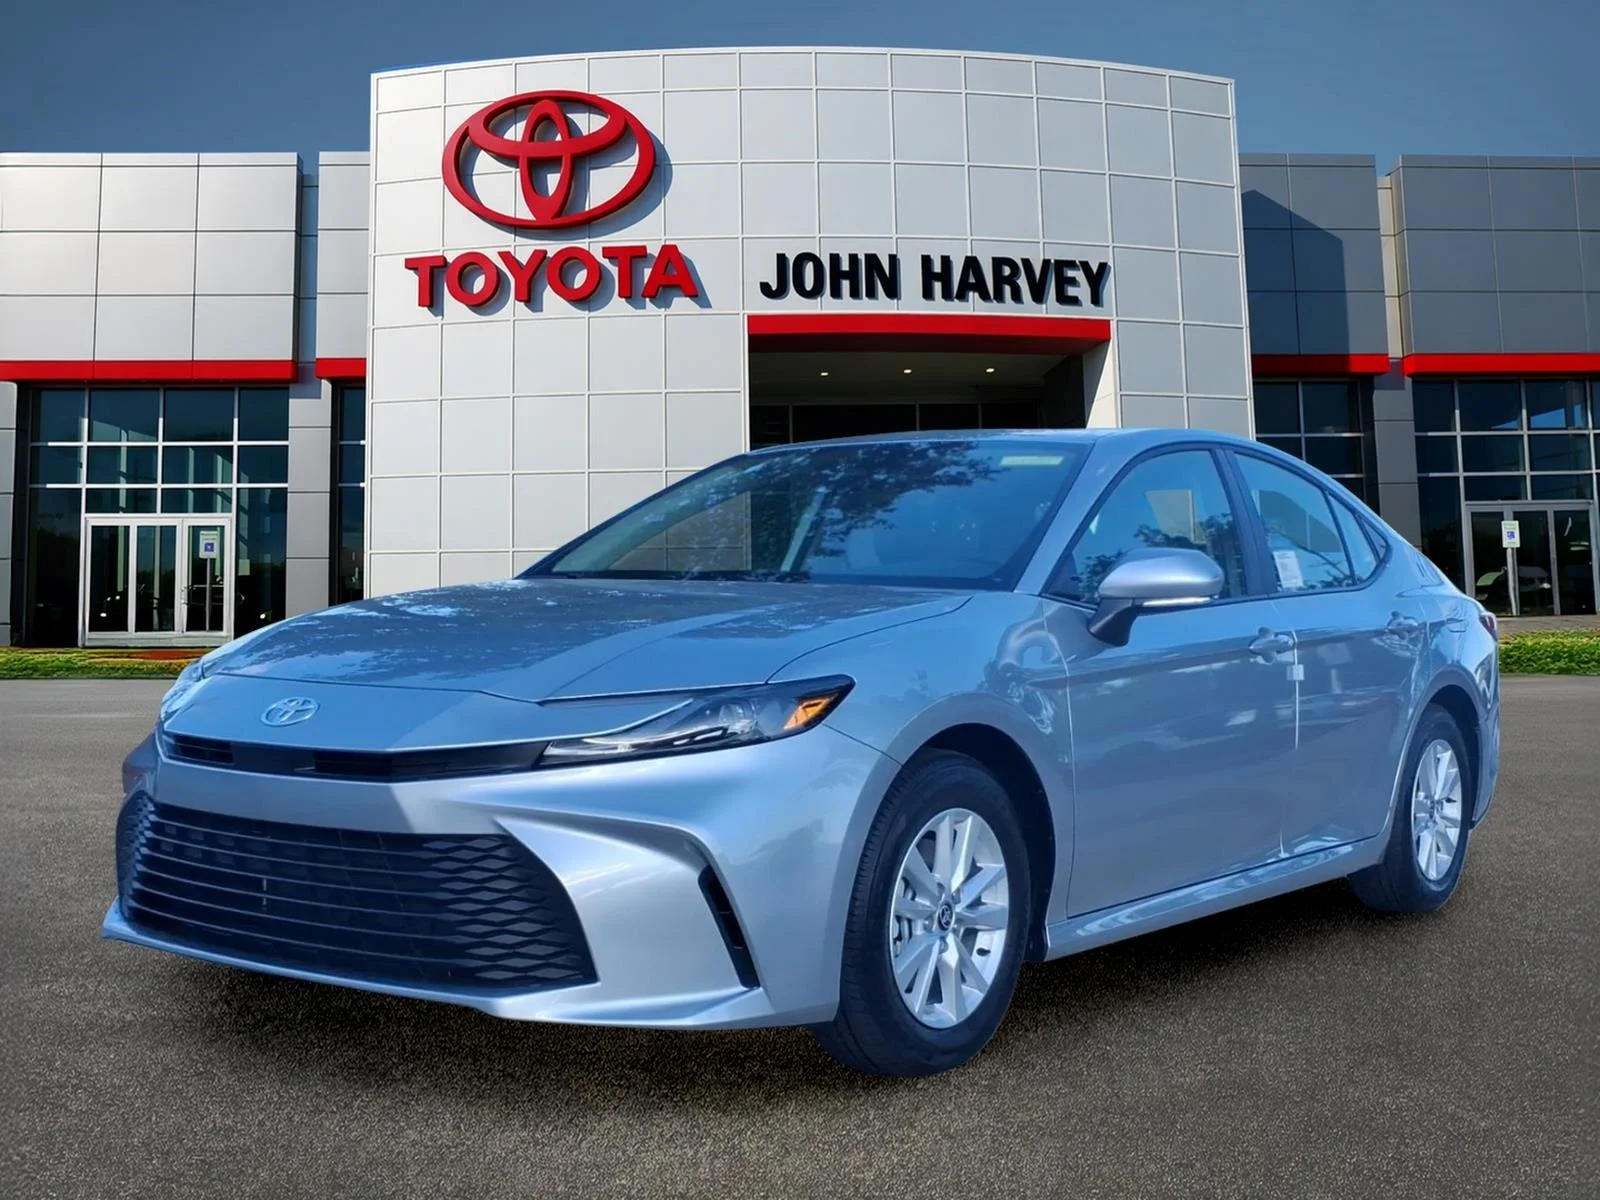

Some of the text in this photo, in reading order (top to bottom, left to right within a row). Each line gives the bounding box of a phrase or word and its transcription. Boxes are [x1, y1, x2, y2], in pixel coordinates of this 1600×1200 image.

[404, 244, 699, 308] TOYOTA
[759, 252, 1109, 307] JOHN HARVEY
